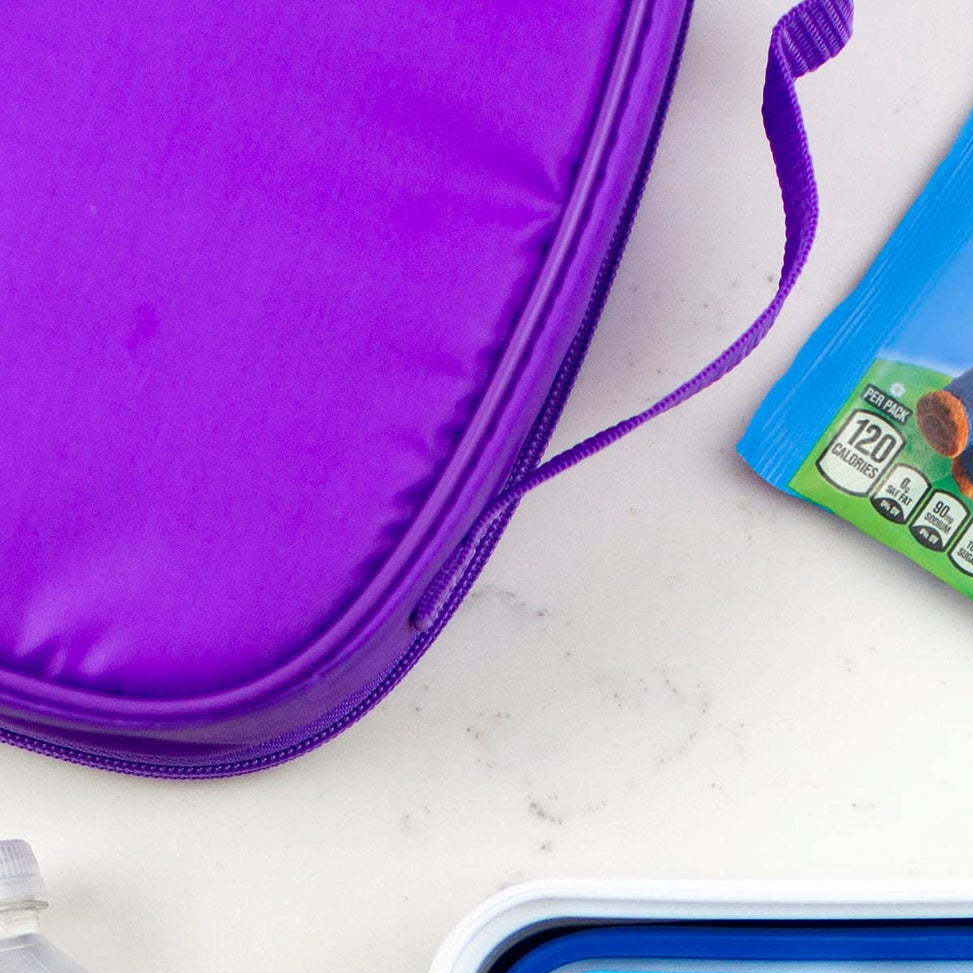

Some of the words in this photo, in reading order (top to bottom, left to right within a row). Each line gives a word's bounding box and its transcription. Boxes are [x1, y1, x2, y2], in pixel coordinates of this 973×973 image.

[864, 387, 883, 408] PER
[884, 398, 911, 422] PACK
[847, 419, 897, 463] 120
[831, 443, 879, 479] CALORIES
[899, 493, 912, 506] FAT
[924, 512, 952, 535] SODIUM
